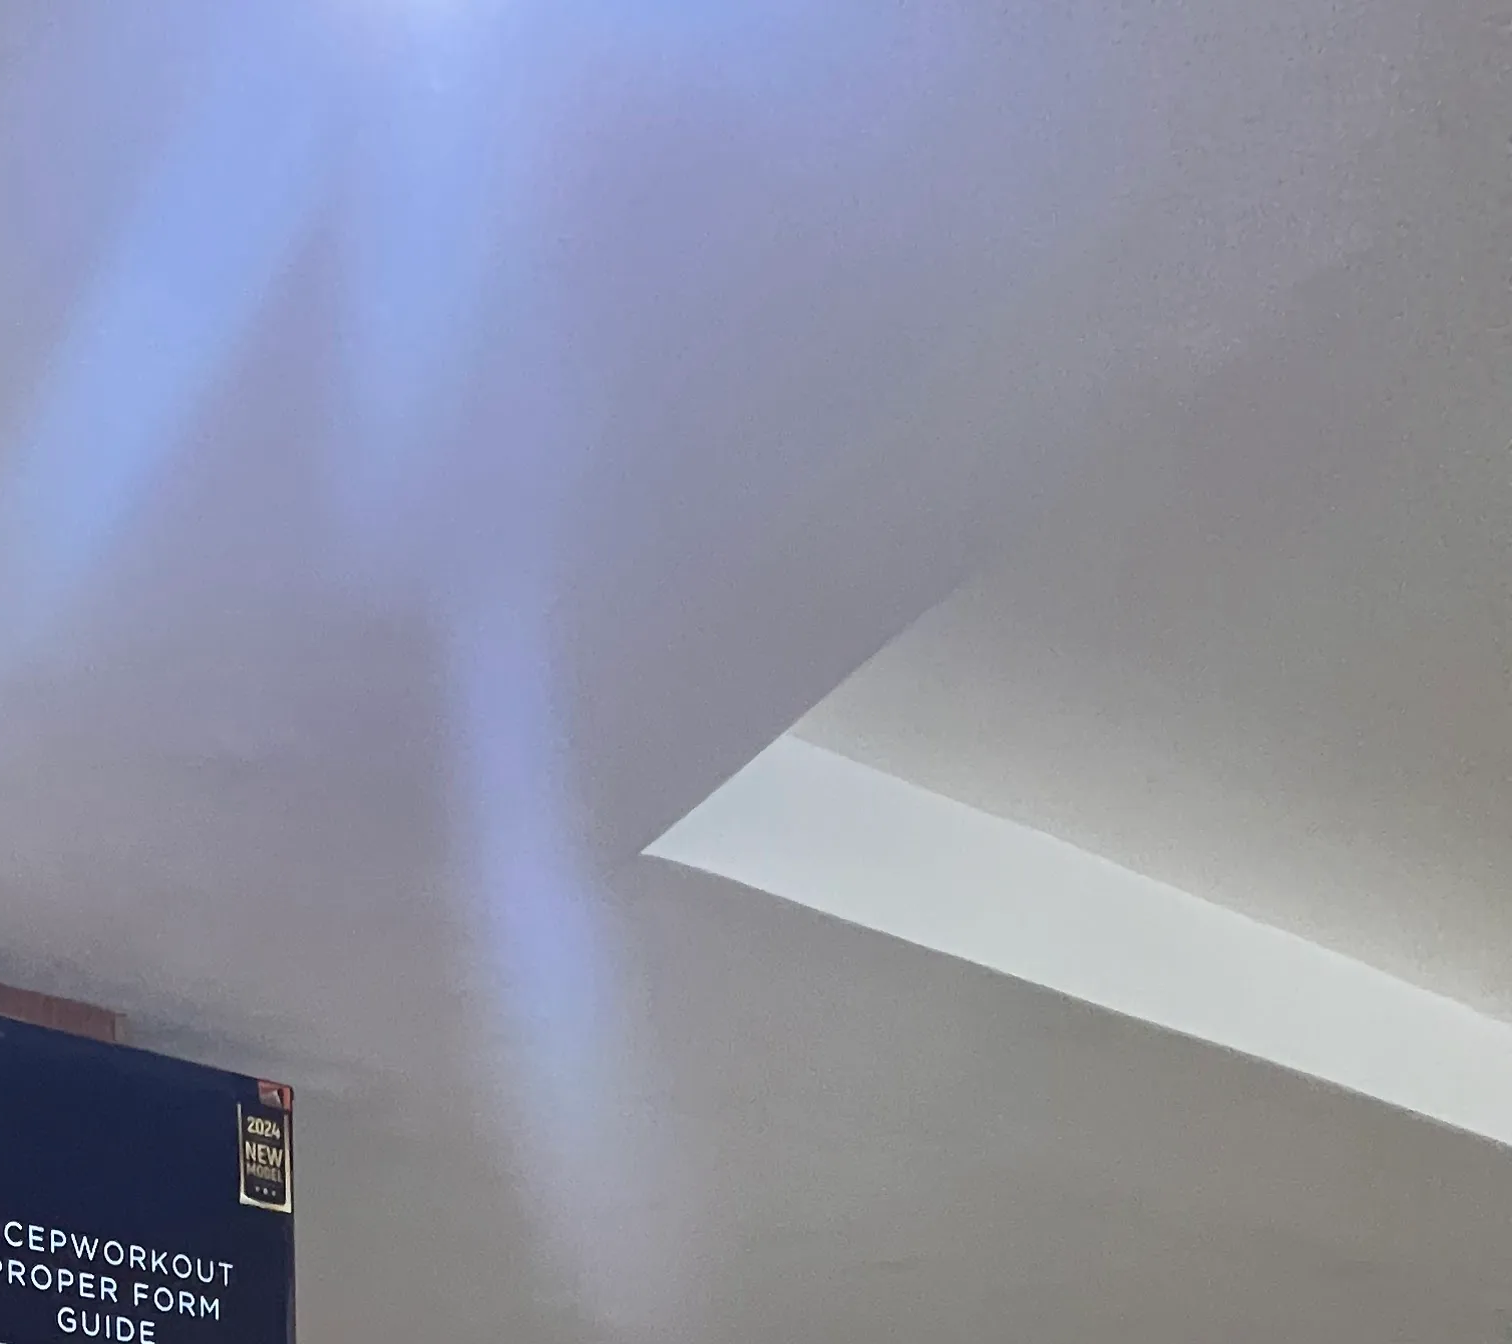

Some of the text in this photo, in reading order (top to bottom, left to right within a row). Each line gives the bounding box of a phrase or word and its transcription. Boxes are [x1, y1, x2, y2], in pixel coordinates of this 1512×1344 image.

[246, 1115, 281, 1139] 2024
[245, 1140, 283, 1168] NEW
[246, 1162, 283, 1183] MODEL
[133, 1283, 220, 1320] FORM
